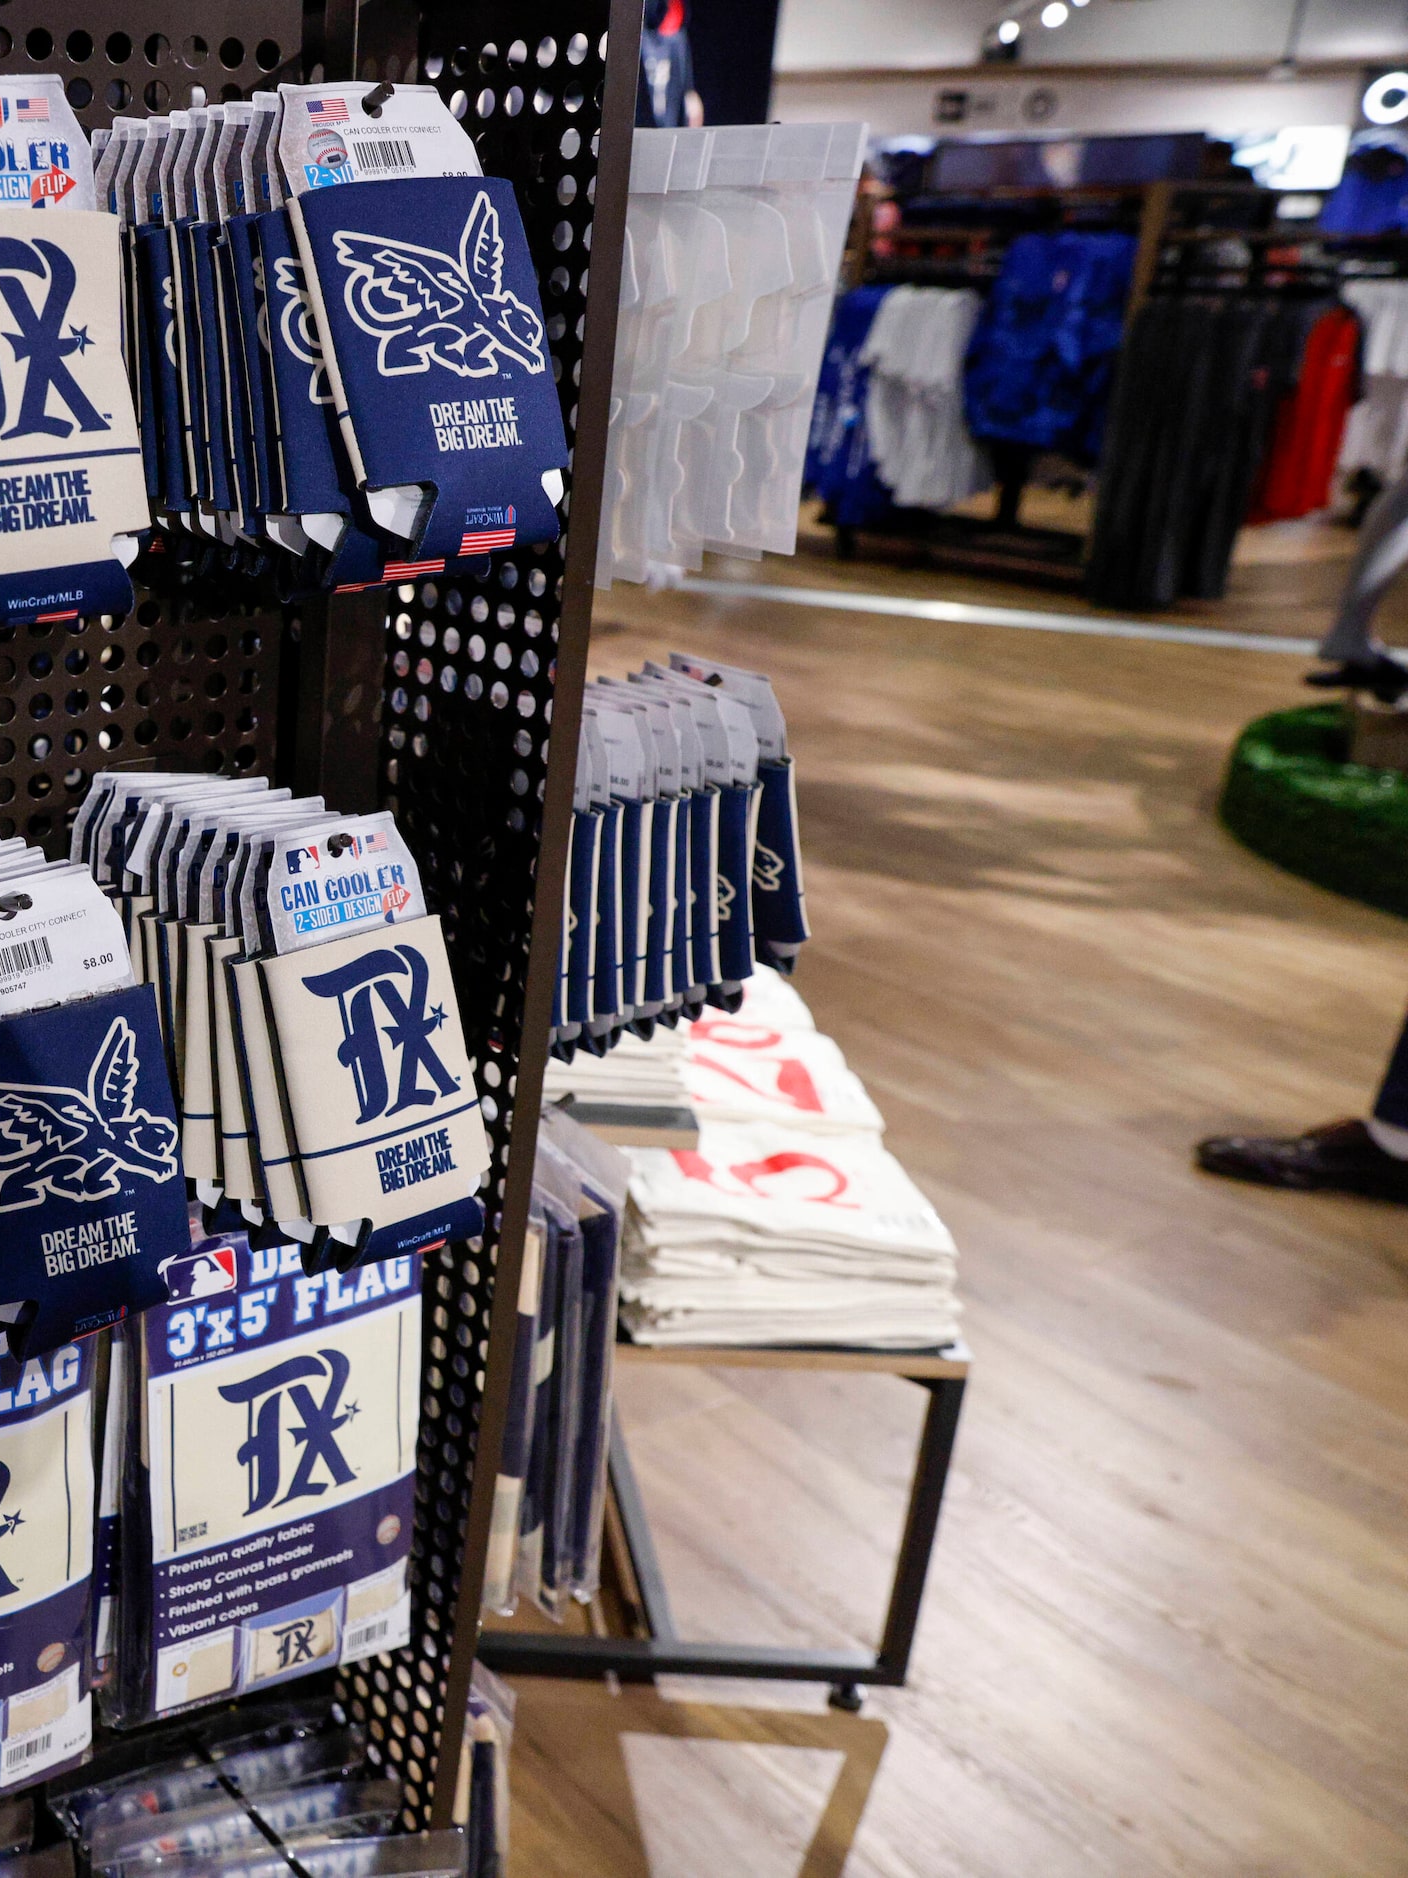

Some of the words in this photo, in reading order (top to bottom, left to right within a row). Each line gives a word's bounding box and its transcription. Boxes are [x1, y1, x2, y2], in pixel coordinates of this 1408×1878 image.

[343, 127, 360, 136] CAN
[361, 126, 391, 135] COOLER
[392, 126, 407, 134] CITY
[409, 126, 442, 134] CONNECT
[39, 174, 68, 195] FLIP
[429, 399, 489, 428] DREAM
[487, 397, 519, 423] THE
[435, 425, 465, 452] BIG
[464, 421, 523, 449] DREAM.
[53, 469, 92, 498] THE
[23, 497, 97, 531] DREAM.
[7, 589, 85, 610] WinCraft/MLB
[279, 878, 321, 912] CAN
[324, 864, 406, 902] COOLER
[29, 920, 47, 934] CITY
[48, 909, 88, 928] CONNECT
[296, 907, 341, 932] 2-SIDED
[345, 895, 382, 921] DESIGN
[387, 888, 406, 908] FLIP
[82, 952, 114, 971] $8.00
[375, 1136, 427, 1173] DREAM
[425, 1127, 453, 1153] THE
[379, 1168, 406, 1194] BIG
[406, 1150, 458, 1186] DREAM.
[40, 1220, 104, 1256] DREAM
[104, 1211, 139, 1239] THE
[44, 1250, 76, 1278] BIG
[76, 1233, 141, 1270] DREAM.
[293, 1255, 413, 1325] FLAG
[168, 1552, 229, 1578] Premium
[231, 1534, 276, 1560] quality
[277, 1521, 316, 1543] fabric
[168, 1576, 212, 1601] Strong
[214, 1562, 265, 1585] Canvas
[267, 1543, 315, 1567] header
[168, 1592, 223, 1619] Finished
[225, 1583, 253, 1603] with
[254, 1571, 289, 1592] brass
[291, 1549, 354, 1581] grommets
[167, 1614, 217, 1640] Vibrant
[219, 1601, 259, 1623] colors
